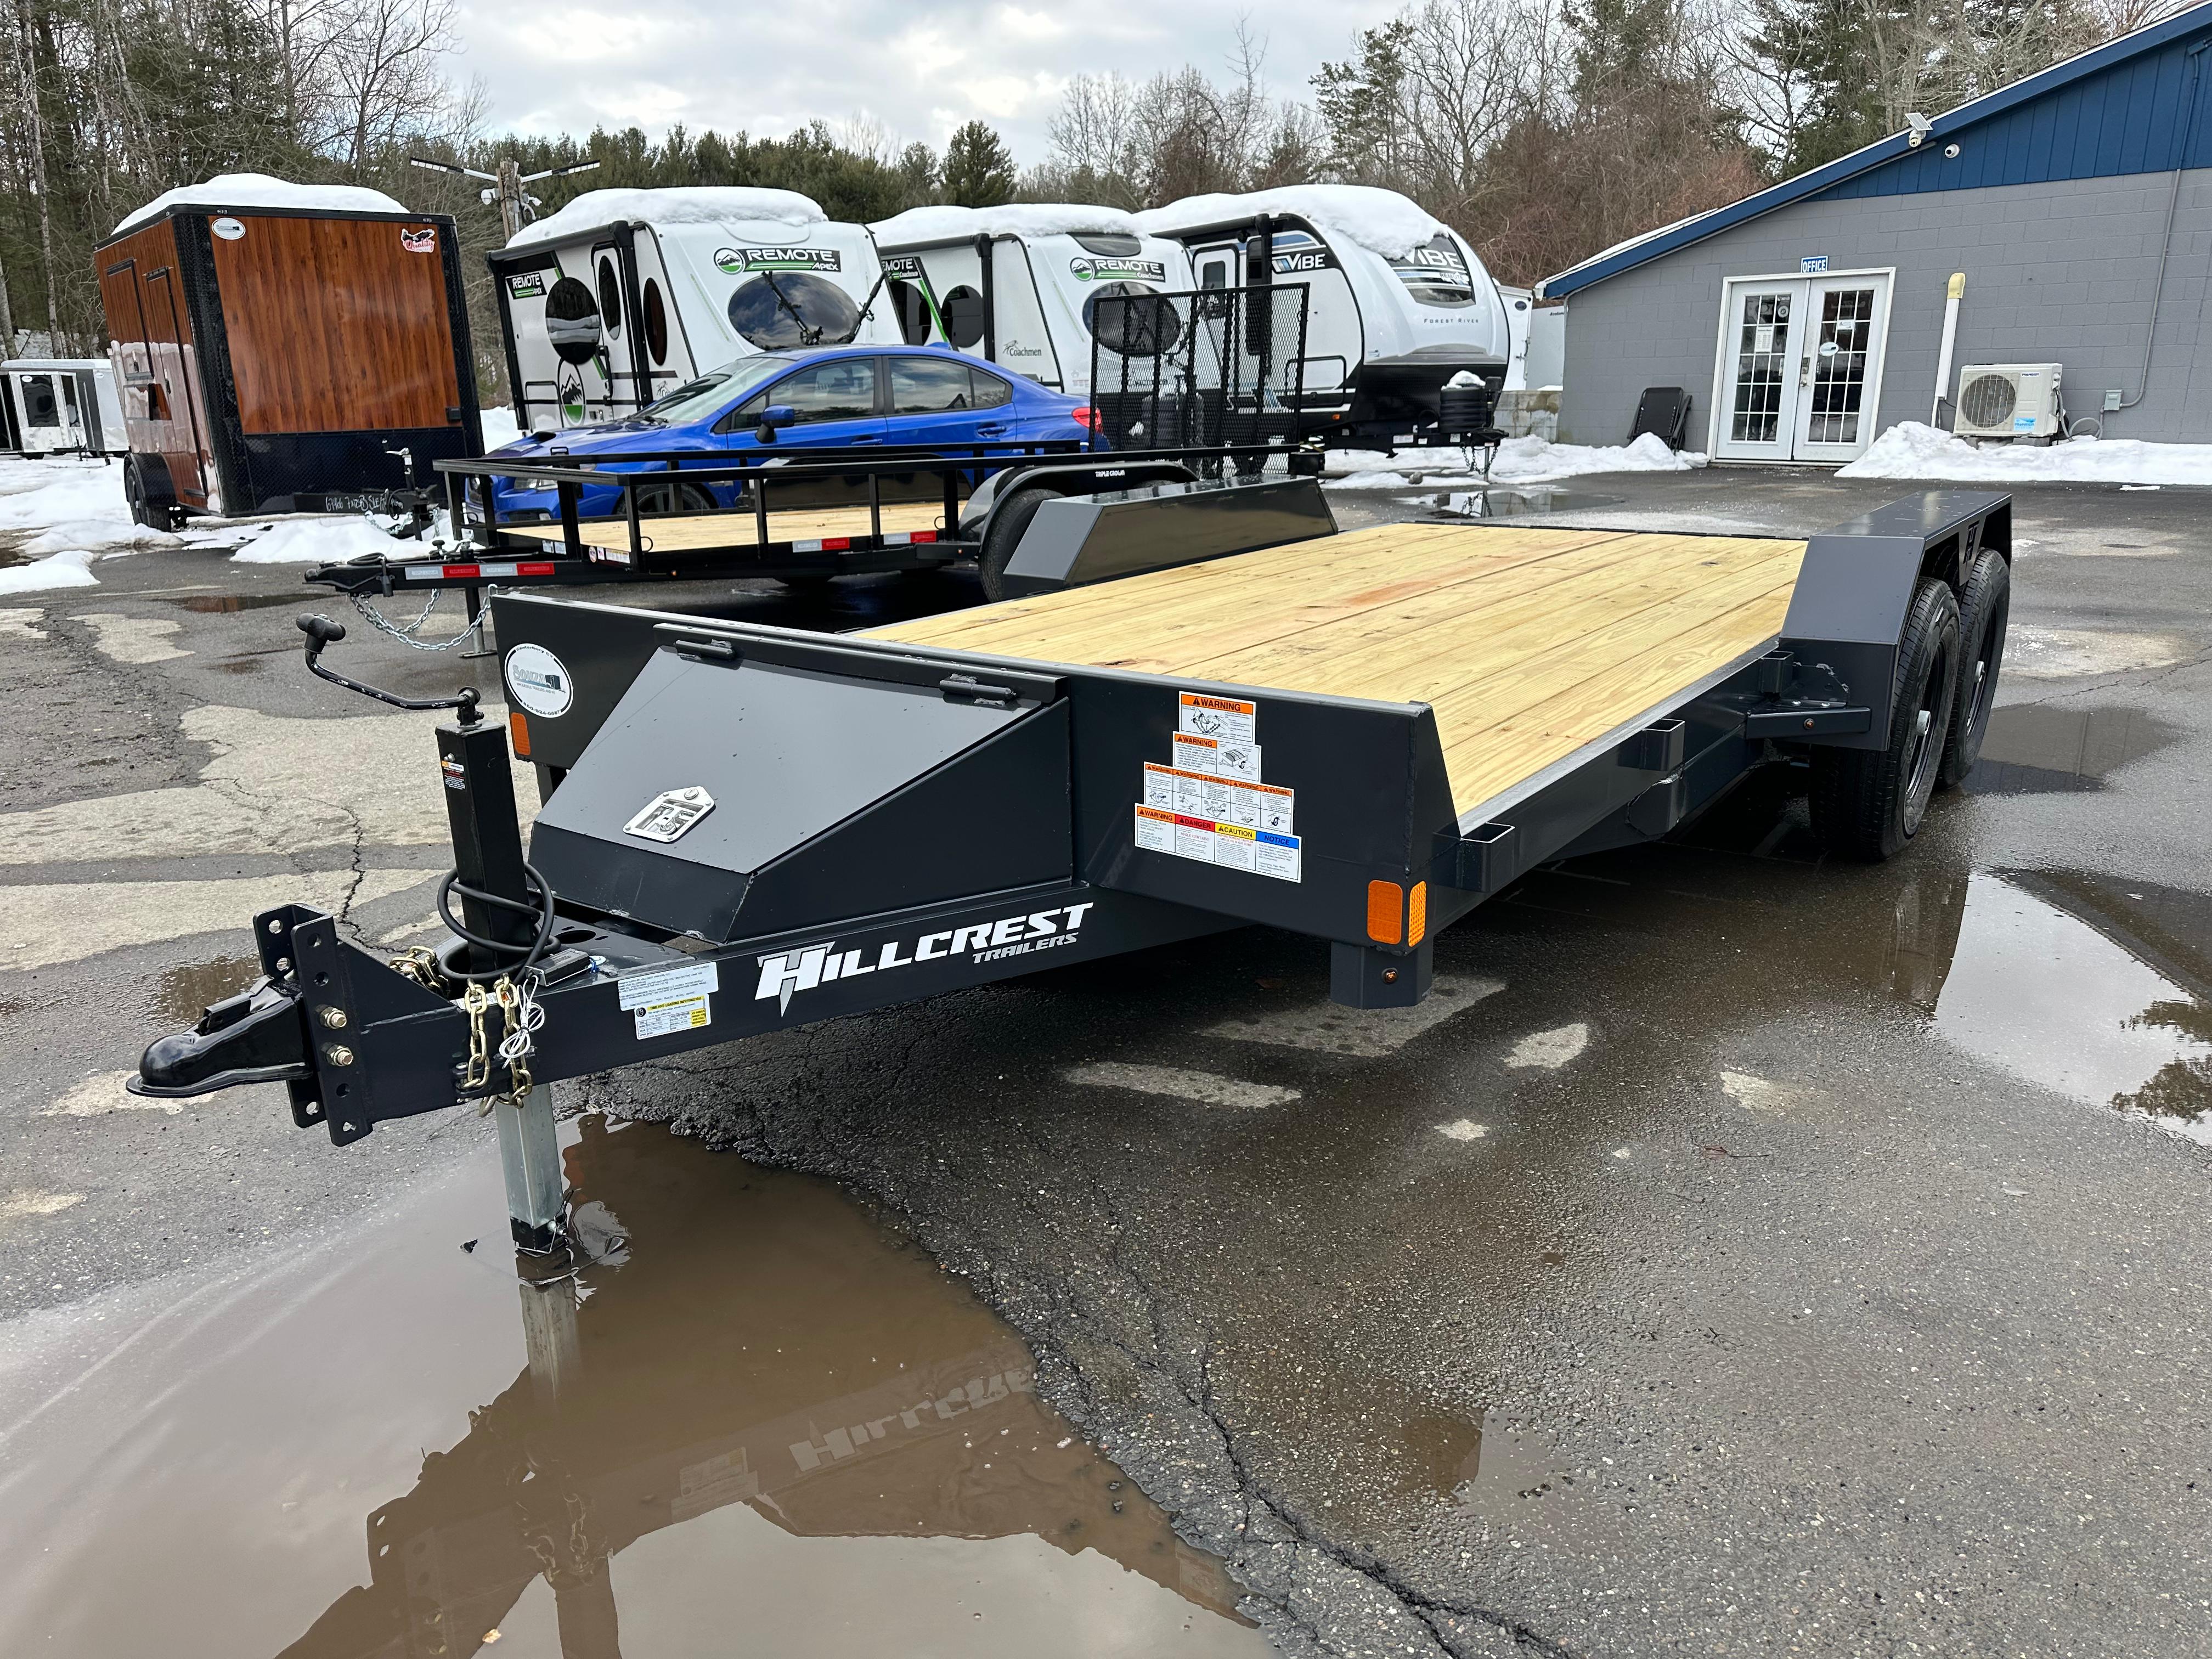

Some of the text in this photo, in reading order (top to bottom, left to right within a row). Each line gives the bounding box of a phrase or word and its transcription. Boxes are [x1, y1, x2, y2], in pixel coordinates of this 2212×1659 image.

[404, 238, 433, 251] Quality
[746, 249, 835, 262] REMOTE
[1278, 253, 1325, 270] VIBE
[1094, 260, 1161, 273] REMOTE
[1802, 259, 1826, 272] OFFICE
[512, 273, 541, 290] REMOTE
[1009, 347, 1042, 357] Coachmen
[1200, 698, 1241, 712] WARNING
[1183, 736, 1212, 747] WARNING
[1144, 809, 1173, 821] WARNING
[1186, 818, 1211, 830] DANGER
[1224, 827, 1252, 838] CAUTION
[1264, 835, 1290, 845] NOTICE
[972, 932, 1079, 964] TRAILERS
[755, 902, 1094, 1017] HILLCREST
